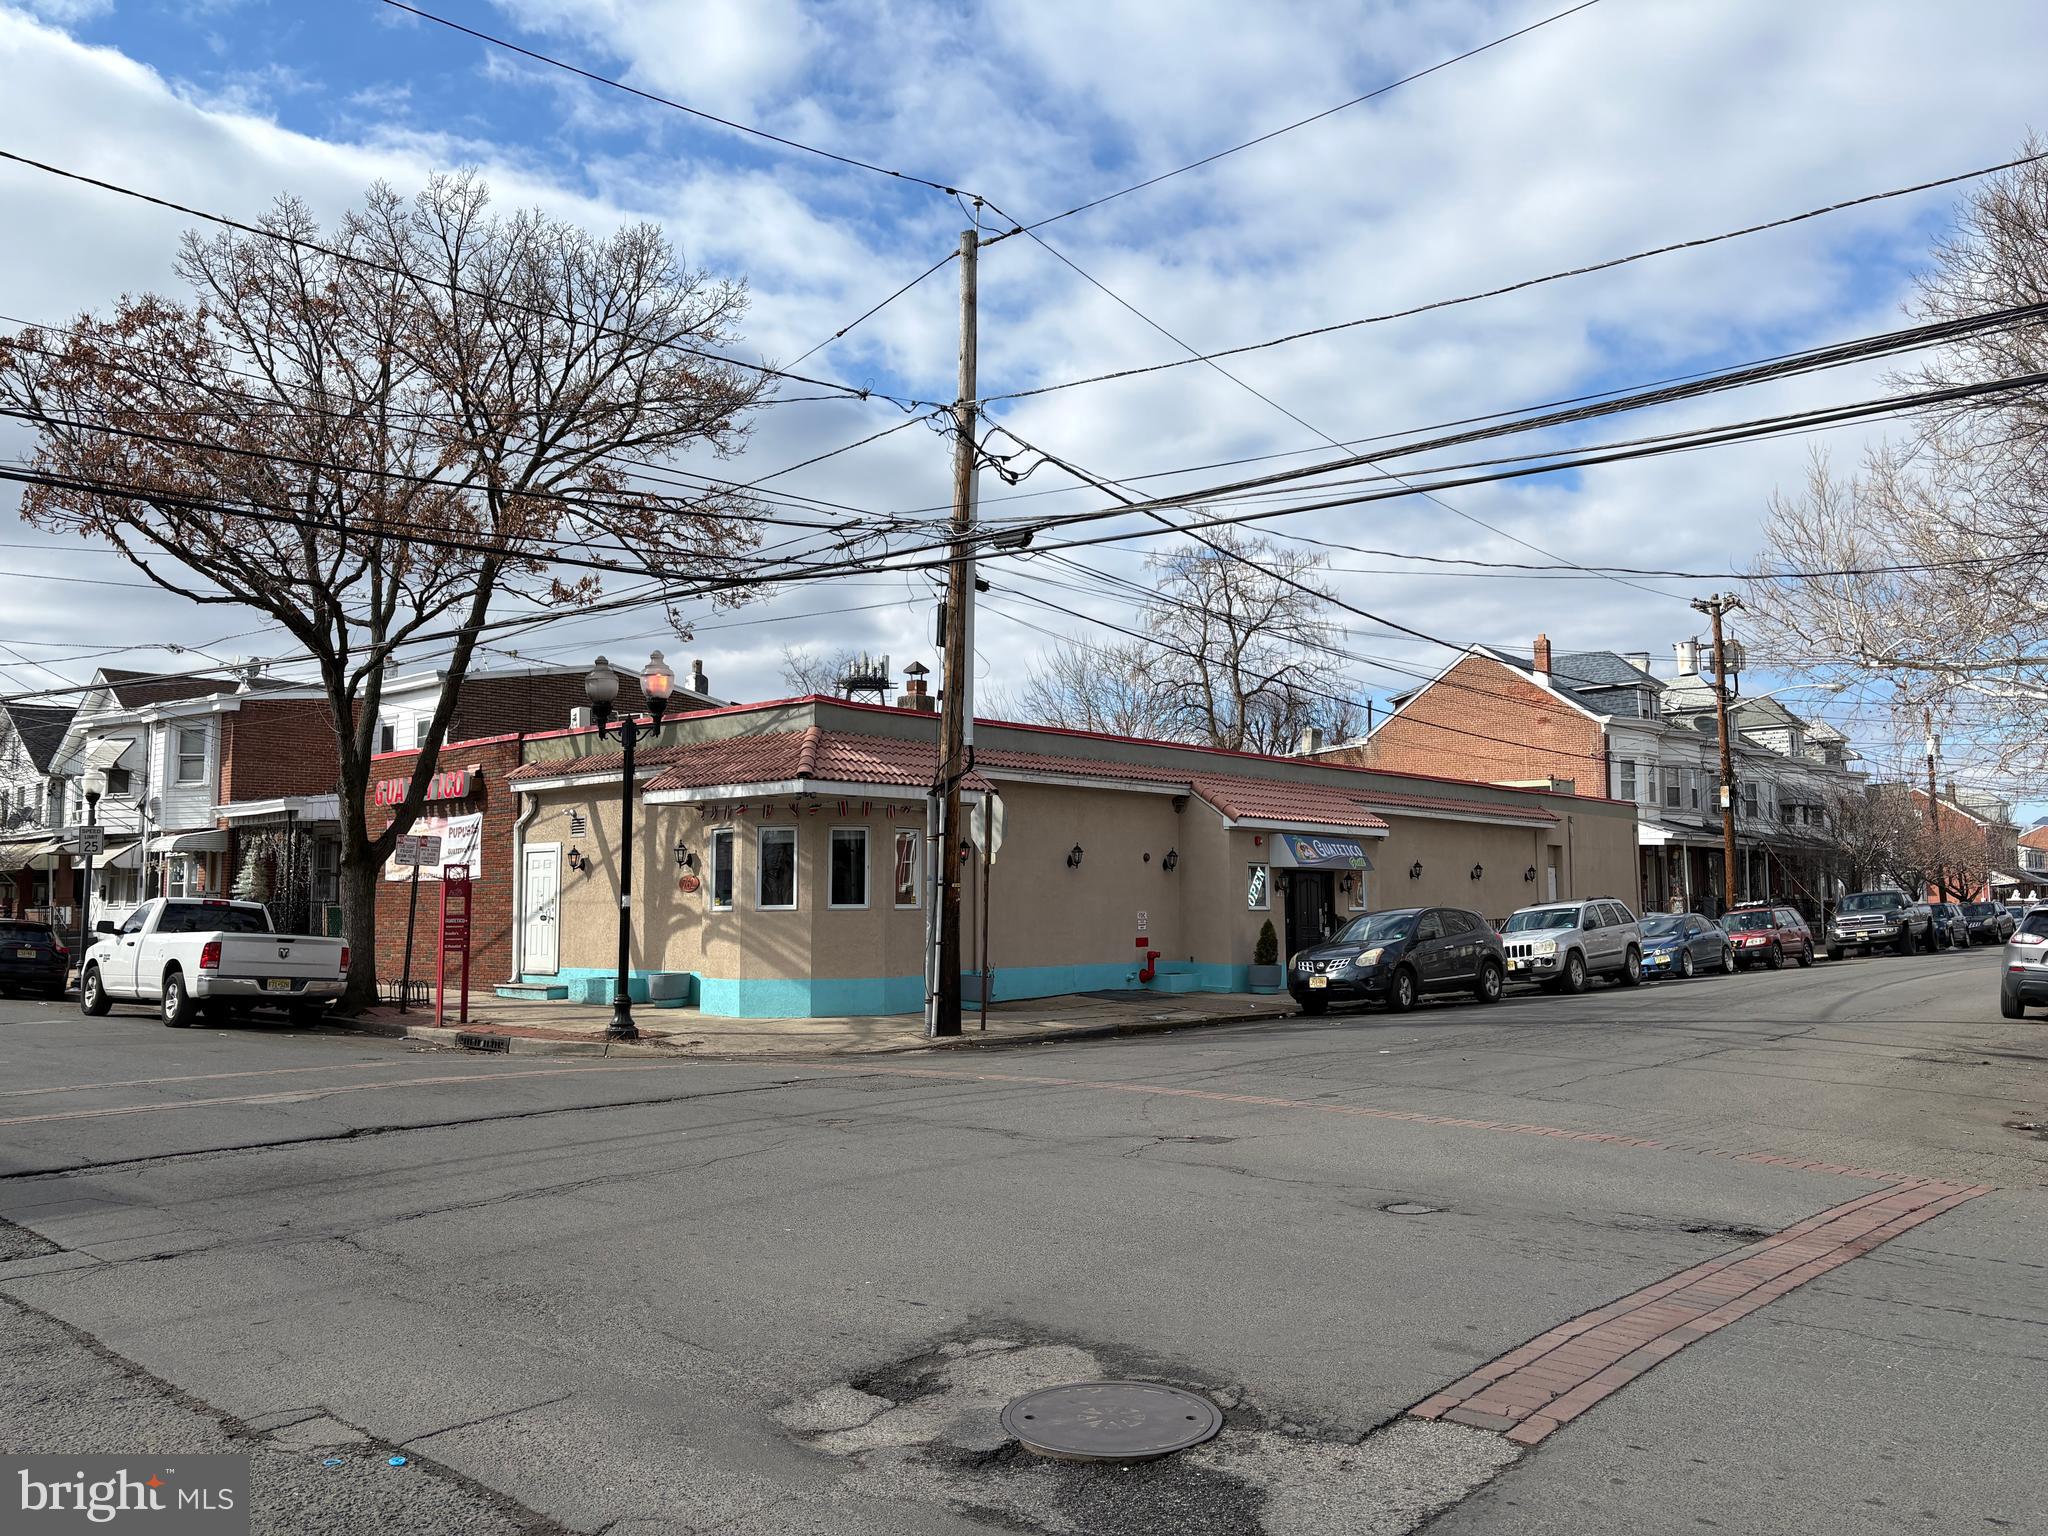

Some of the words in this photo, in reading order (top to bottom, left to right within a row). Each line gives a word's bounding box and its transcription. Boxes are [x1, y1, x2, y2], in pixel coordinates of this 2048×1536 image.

[375, 770, 465, 807] GUATICO
[85, 841, 98, 852] 25
[1248, 866, 1265, 906] OPEN
